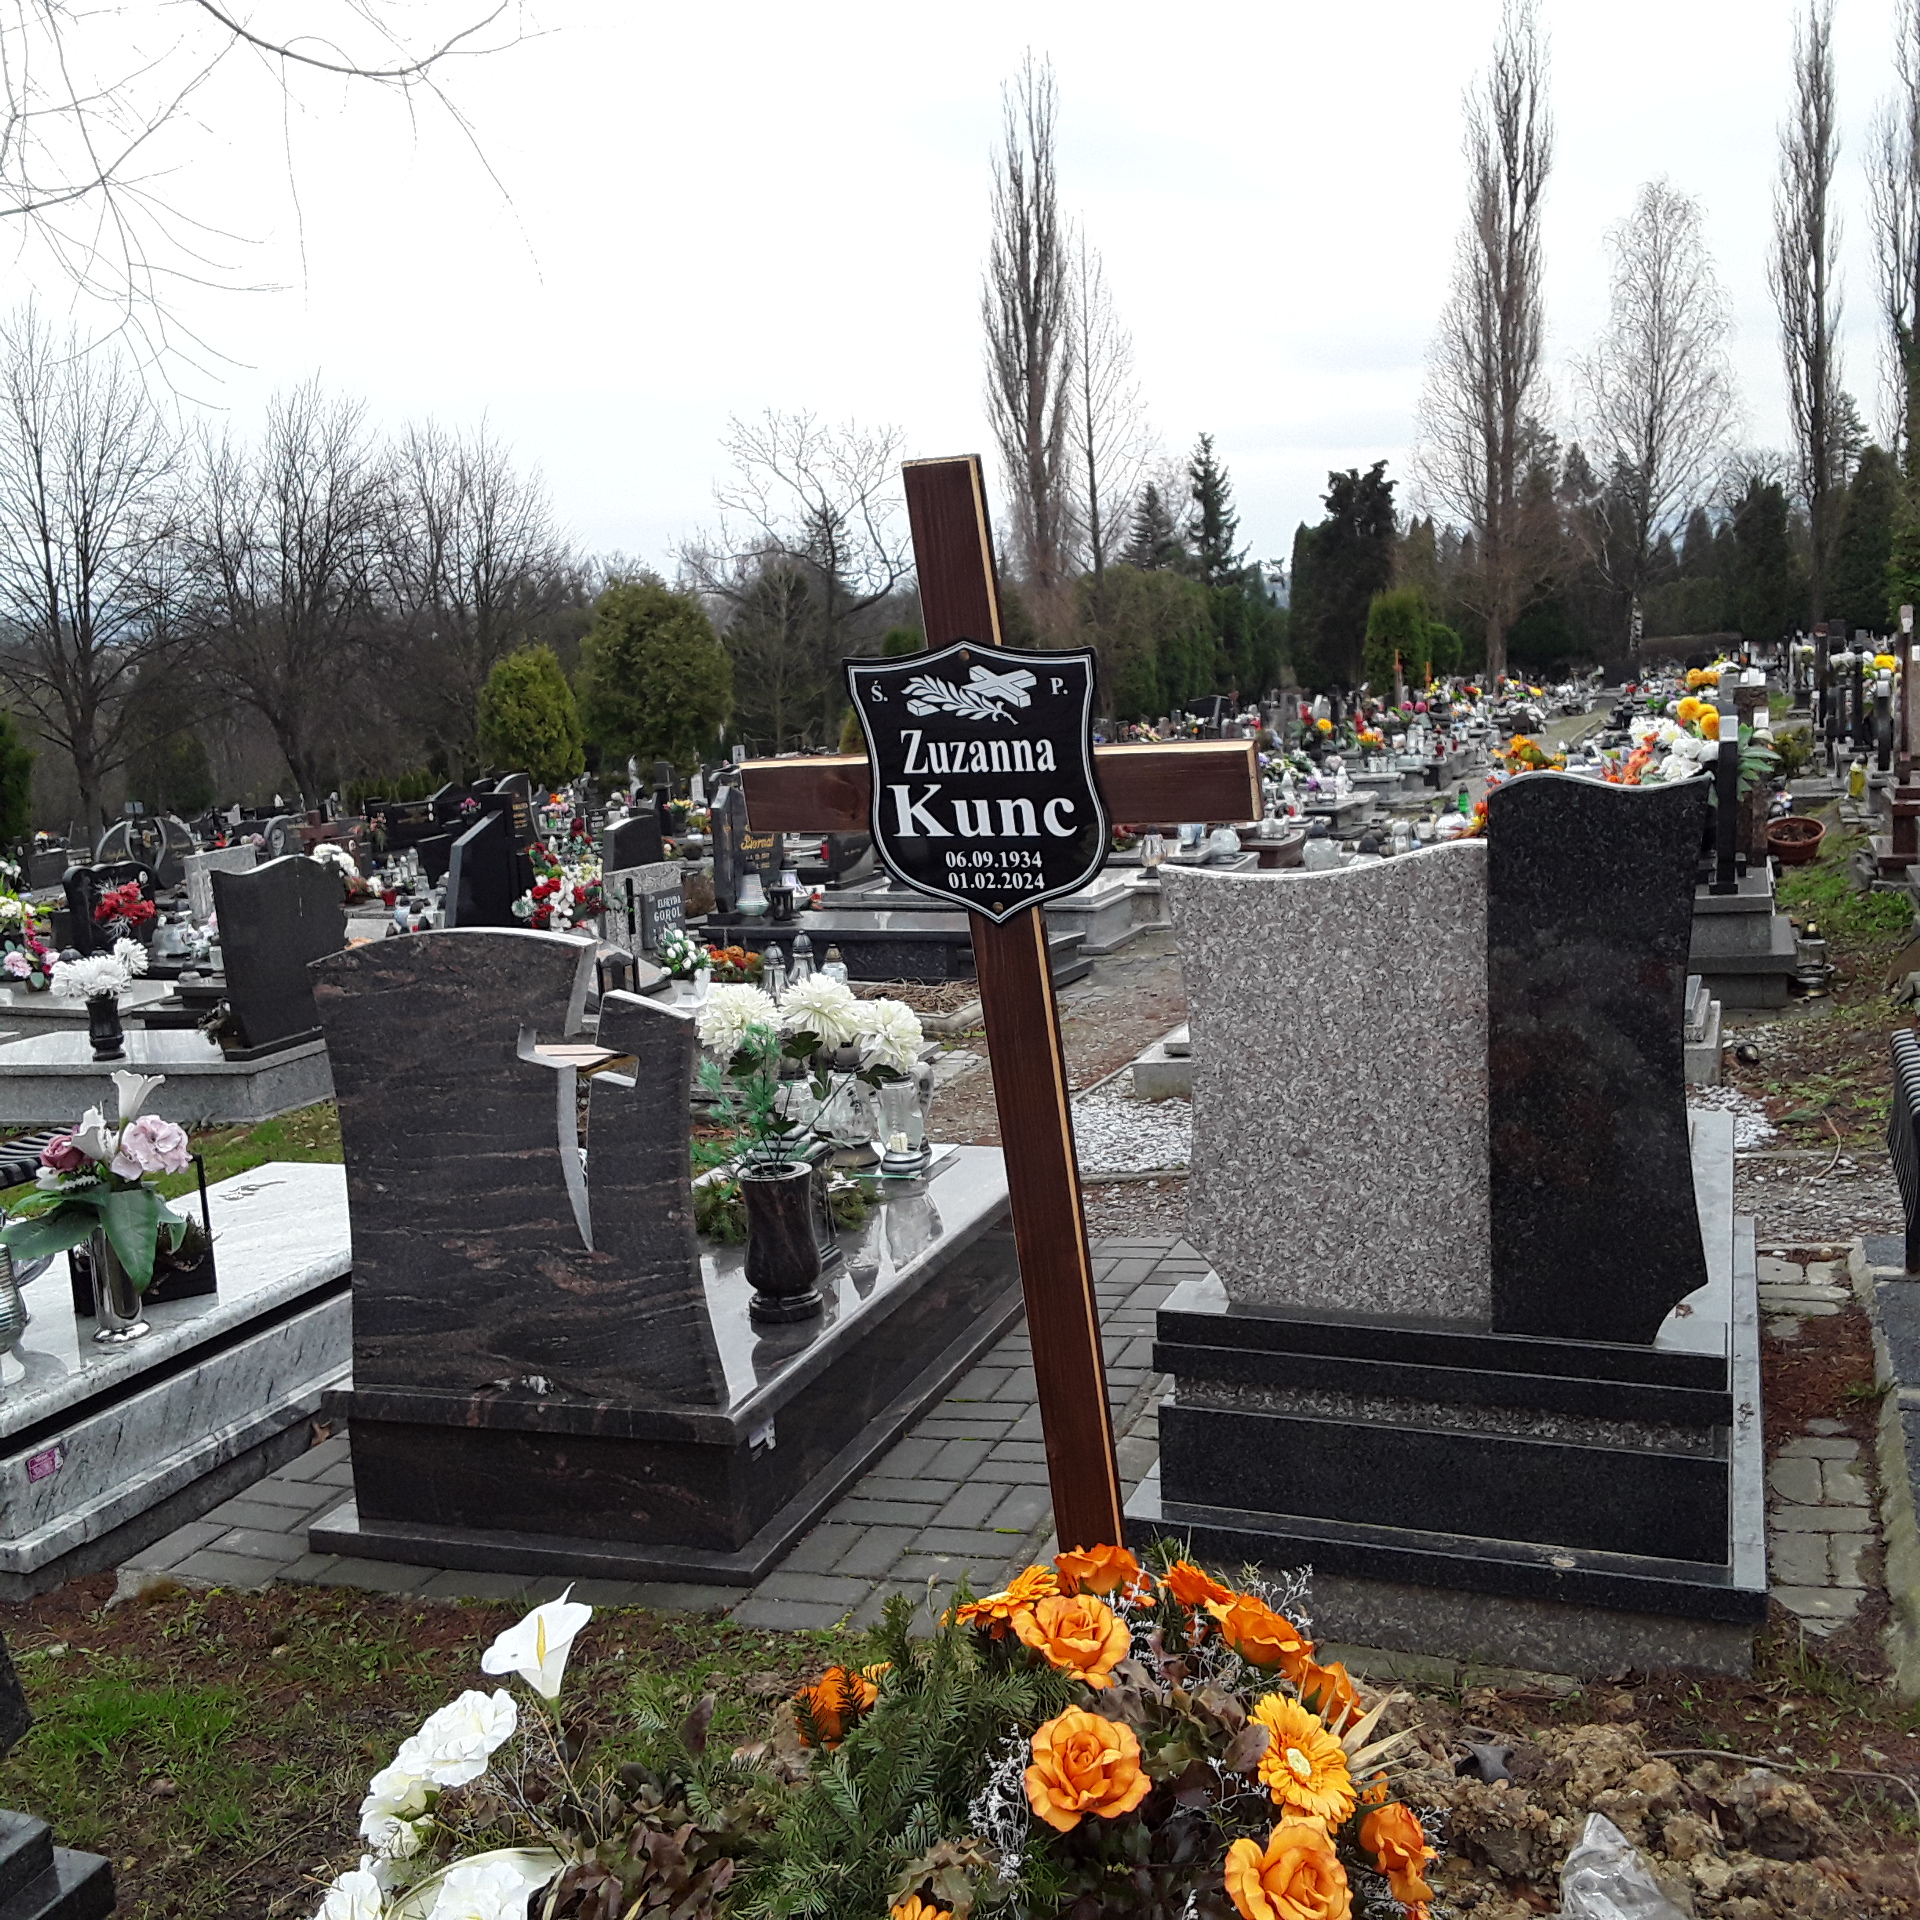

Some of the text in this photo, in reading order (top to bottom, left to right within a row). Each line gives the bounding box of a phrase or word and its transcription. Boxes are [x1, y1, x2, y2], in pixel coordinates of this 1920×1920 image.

[870, 677, 1069, 702] Ś. P.
[900, 729, 1057, 774] Zuzanna
[886, 783, 1078, 838] Kunc
[945, 850, 1043, 868] 06.09.1934
[948, 872, 1045, 890] 01.02.2024
